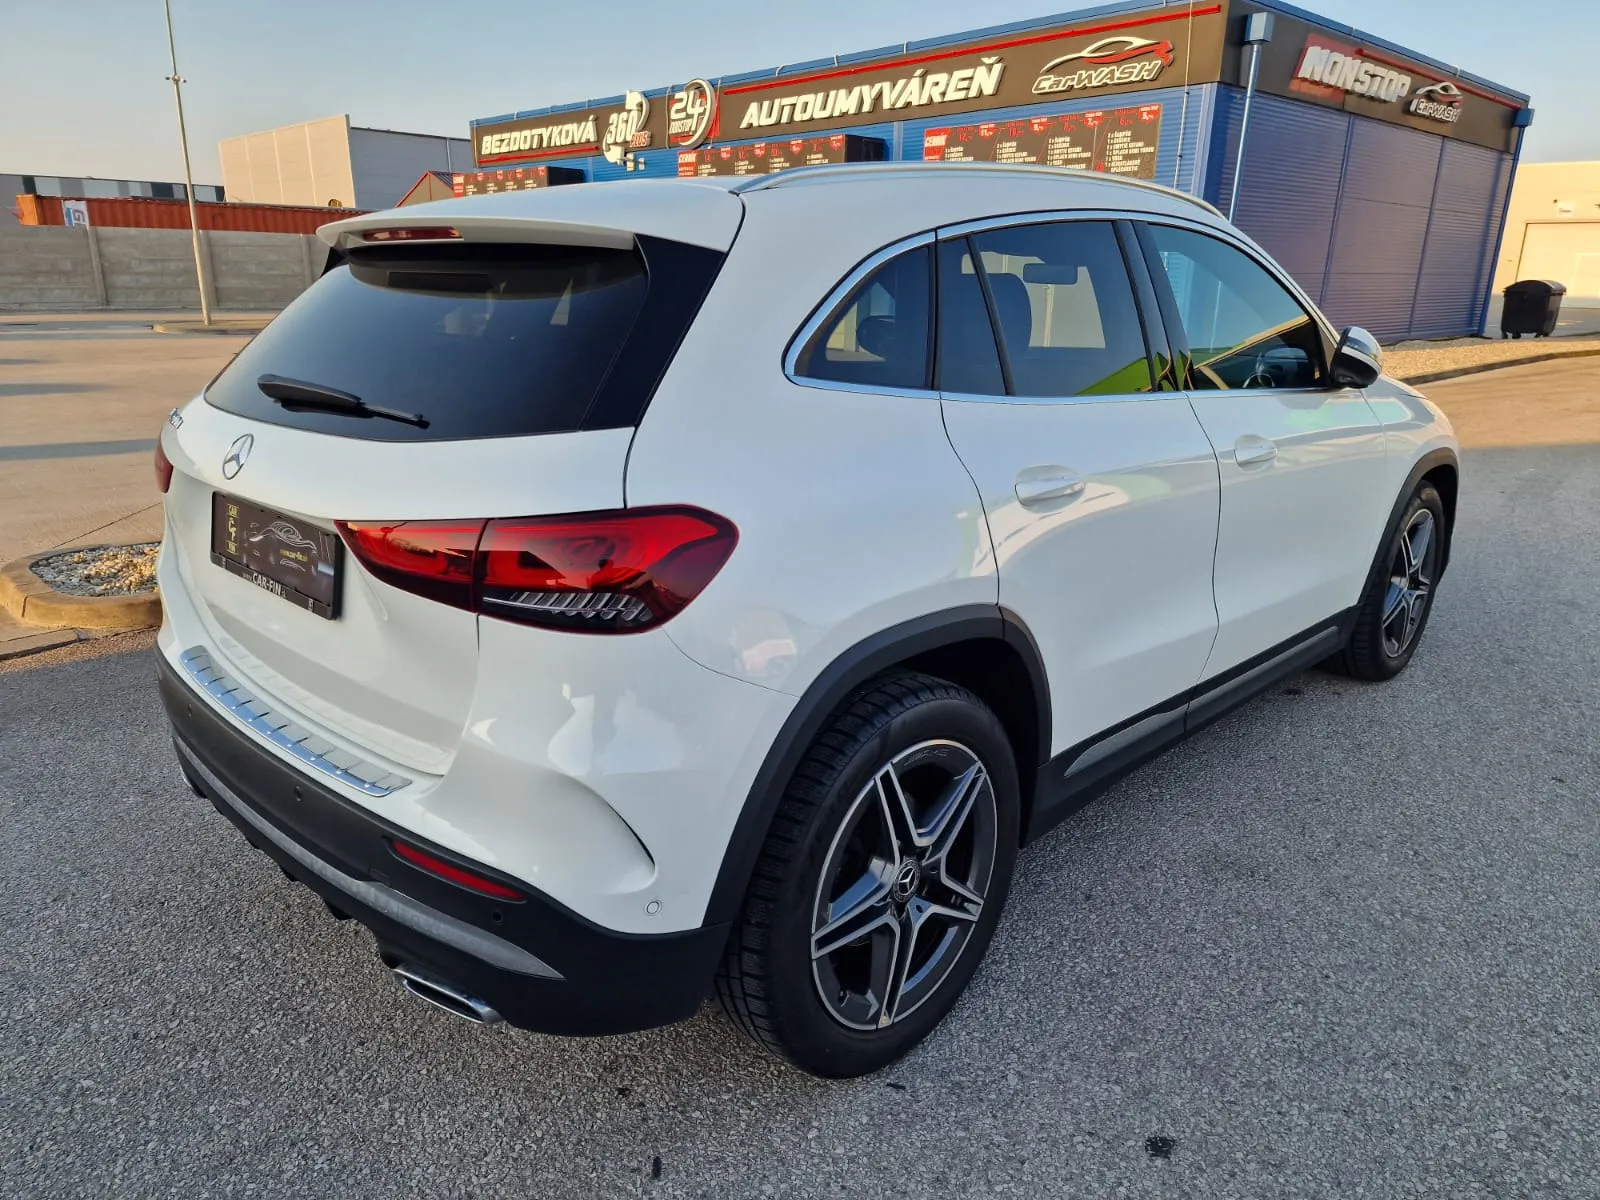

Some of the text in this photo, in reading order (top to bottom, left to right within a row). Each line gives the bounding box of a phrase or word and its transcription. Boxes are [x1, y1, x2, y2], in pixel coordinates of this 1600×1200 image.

[739, 56, 1006, 129] AUTOUMYVÁREŇ
[1032, 60, 1164, 94] CarWASH
[1298, 46, 1411, 103] NONSTOP
[606, 110, 640, 144] 360
[670, 90, 706, 132] 24
[481, 115, 598, 155] BEZDOTYKOVÁ
[252, 572, 281, 596] CAR-FIN
